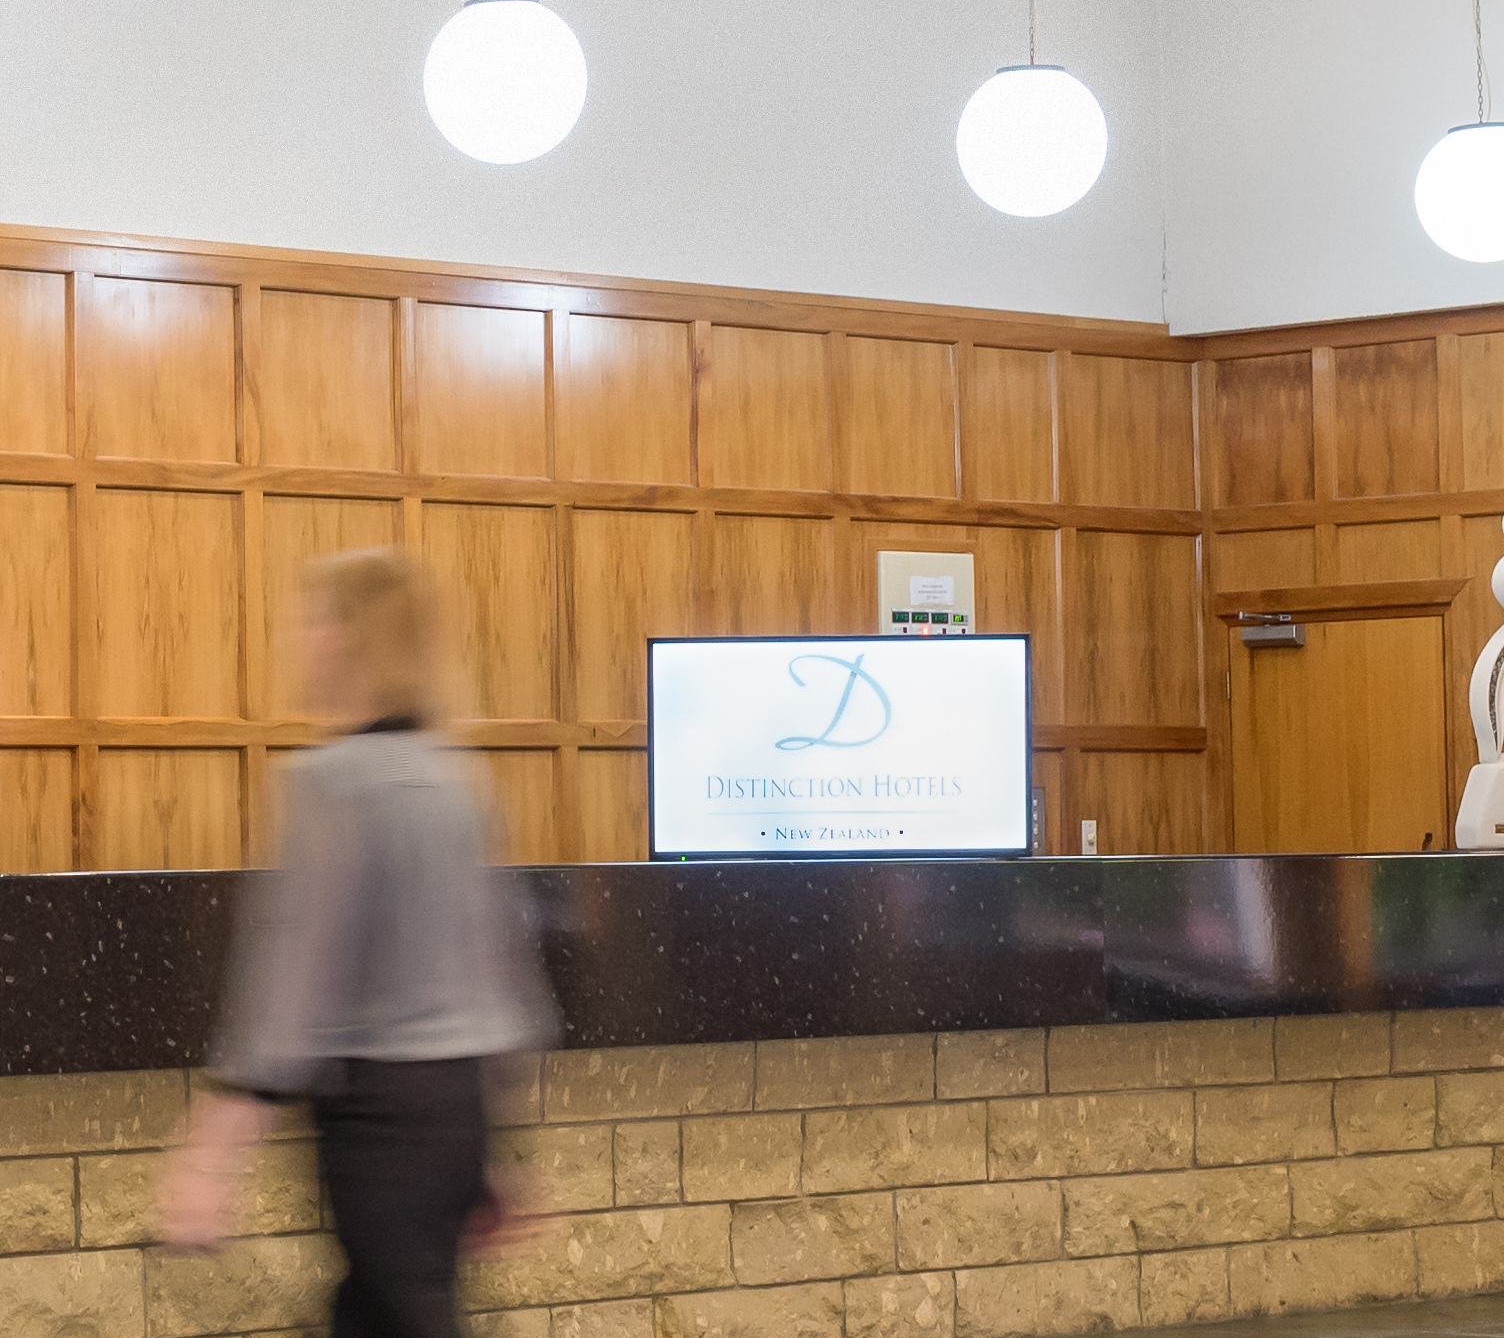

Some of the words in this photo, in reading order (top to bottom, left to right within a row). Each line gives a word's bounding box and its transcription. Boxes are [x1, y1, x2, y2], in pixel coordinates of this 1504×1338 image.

[775, 653, 892, 751] D
[706, 775, 863, 800] DISTINCTION
[874, 775, 962, 798] HOTELS
[775, 827, 812, 840] NEW
[818, 828, 890, 840] ZEALAND
